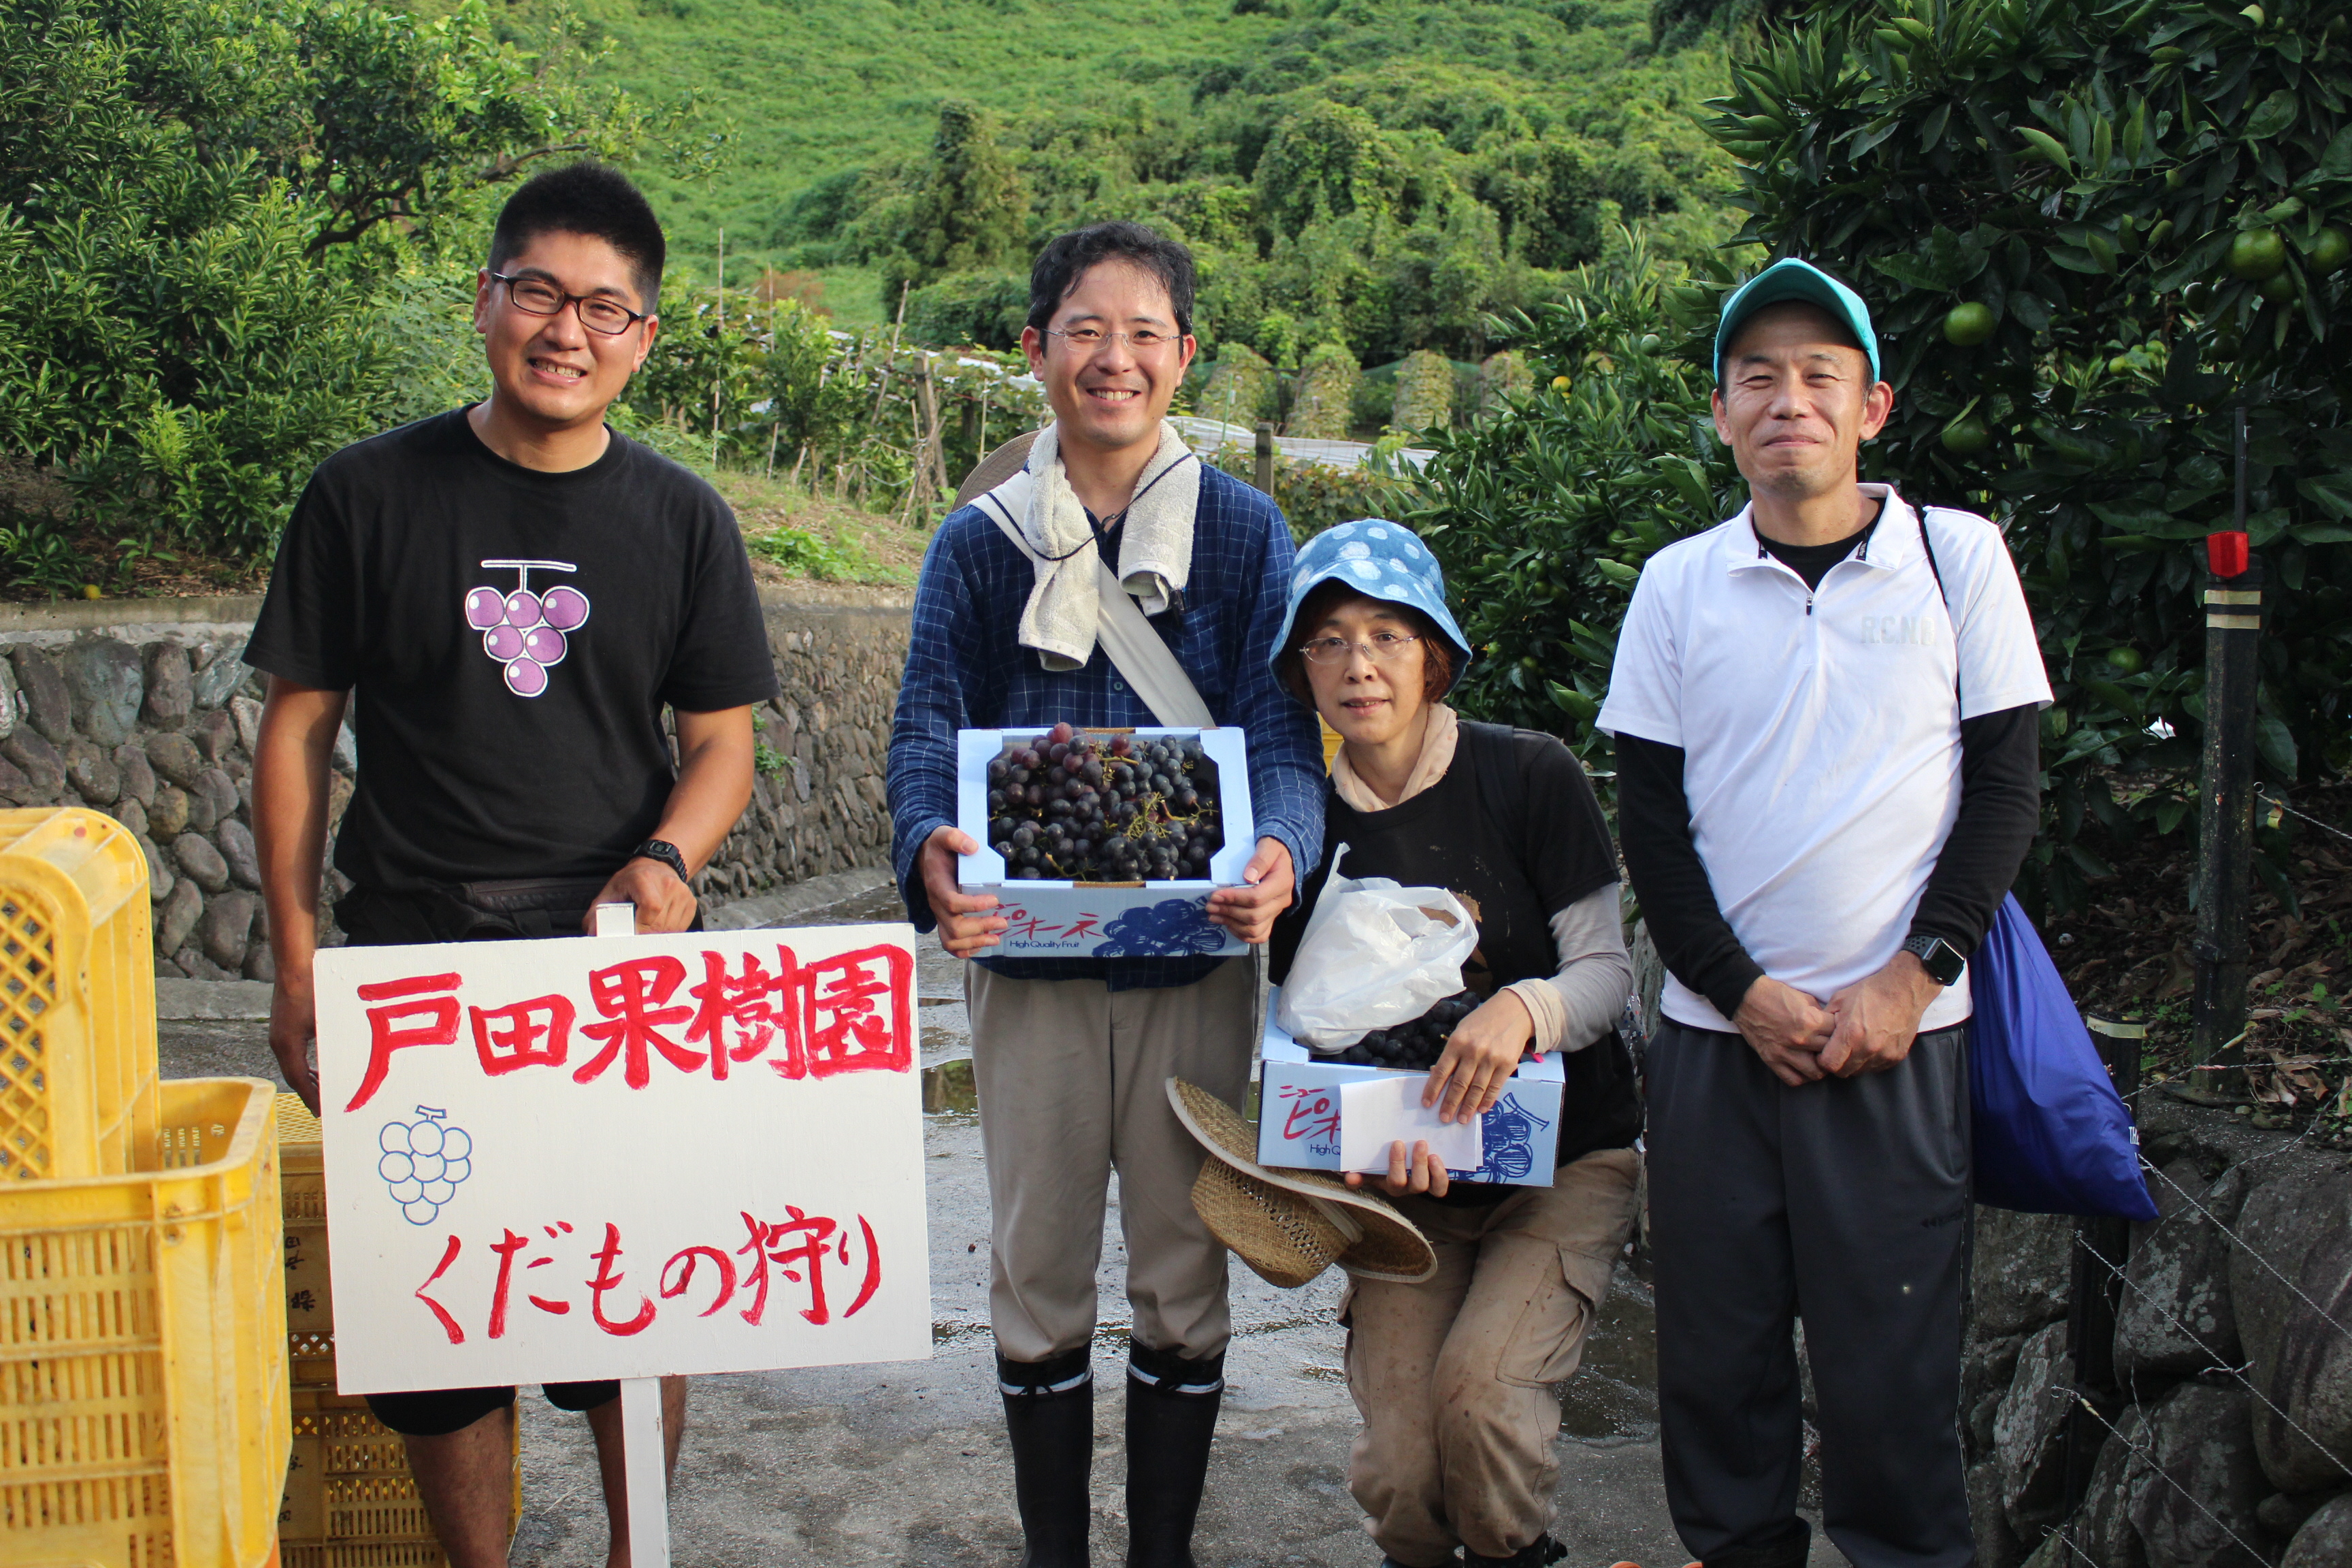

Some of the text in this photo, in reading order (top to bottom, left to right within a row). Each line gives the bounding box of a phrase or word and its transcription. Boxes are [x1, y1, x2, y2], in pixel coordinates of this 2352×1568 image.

[1030, 941, 1061, 949] Quality
[344, 943, 913, 1112] 戸田果樹園
[1284, 1097, 1341, 1145] ピオ
[1310, 1144, 1330, 1156] High
[414, 1205, 881, 1345] くだもの狩り
